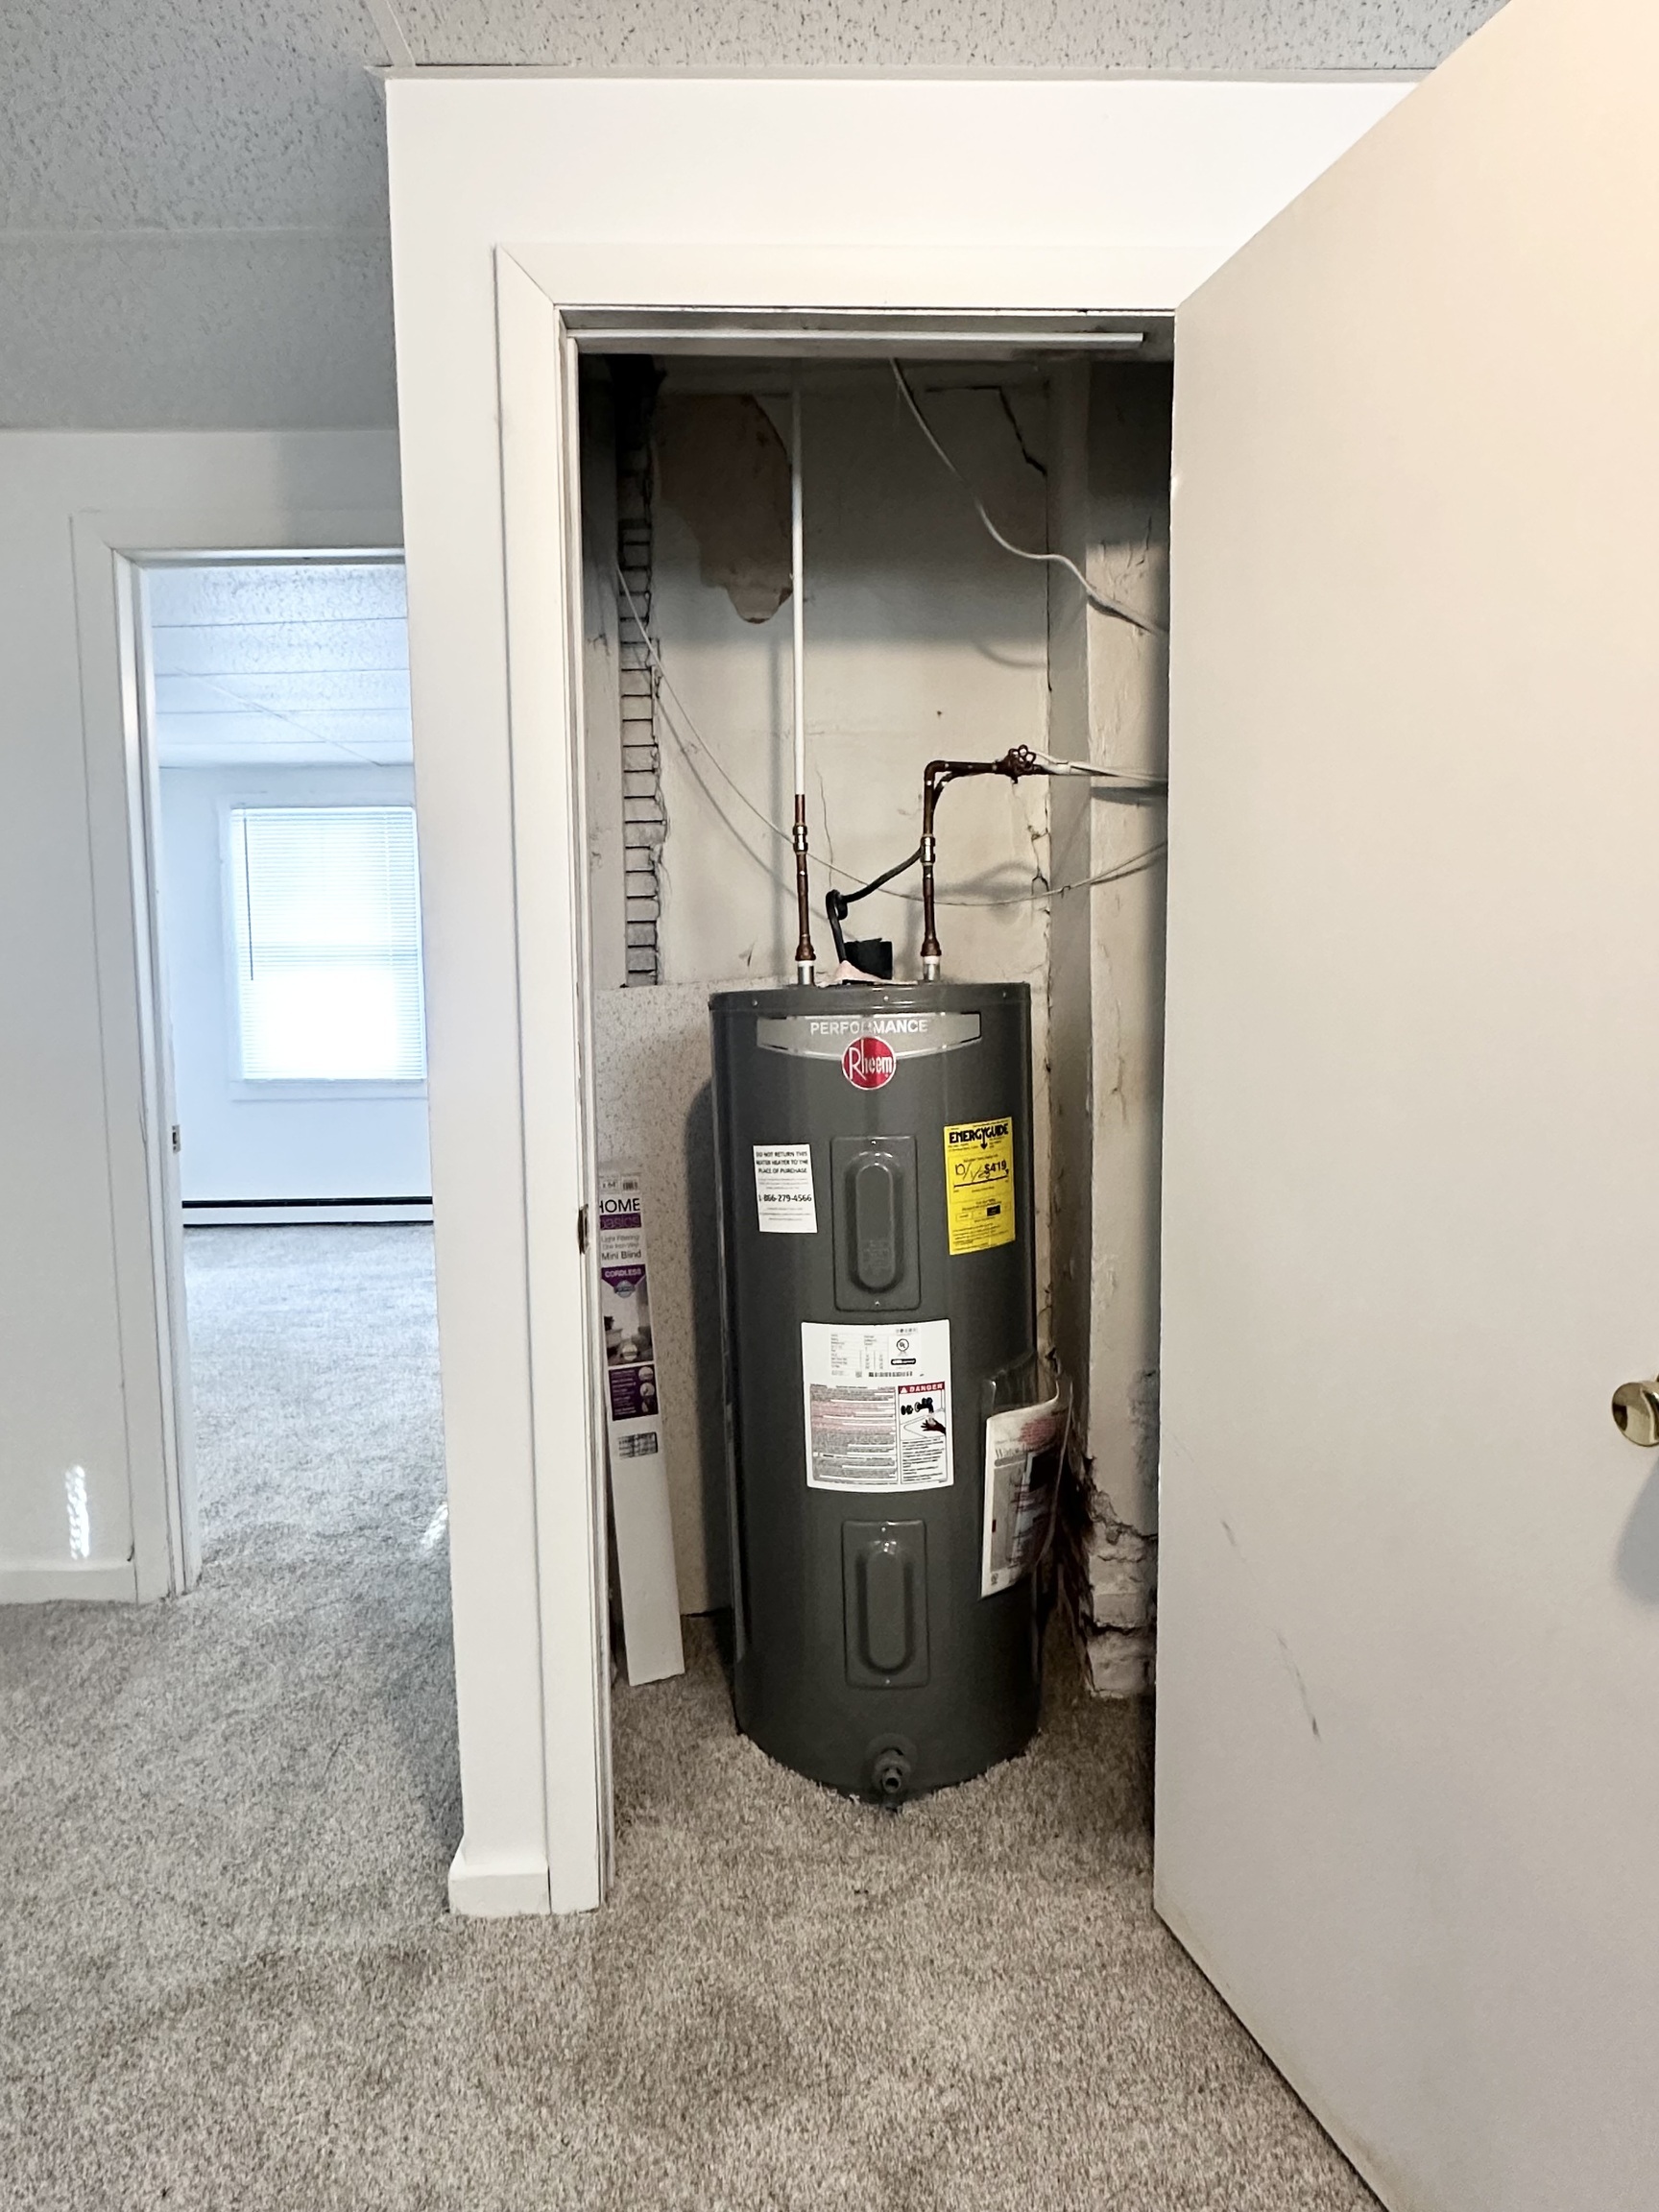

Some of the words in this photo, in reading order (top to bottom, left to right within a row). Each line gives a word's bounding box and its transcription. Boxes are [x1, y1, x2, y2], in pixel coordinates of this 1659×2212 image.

[849, 1039, 893, 1081] Rheem
[621, 1250, 641, 1259] Blind
[605, 1268, 641, 1278] CORDLESS
[909, 1383, 943, 1392] DANGER
